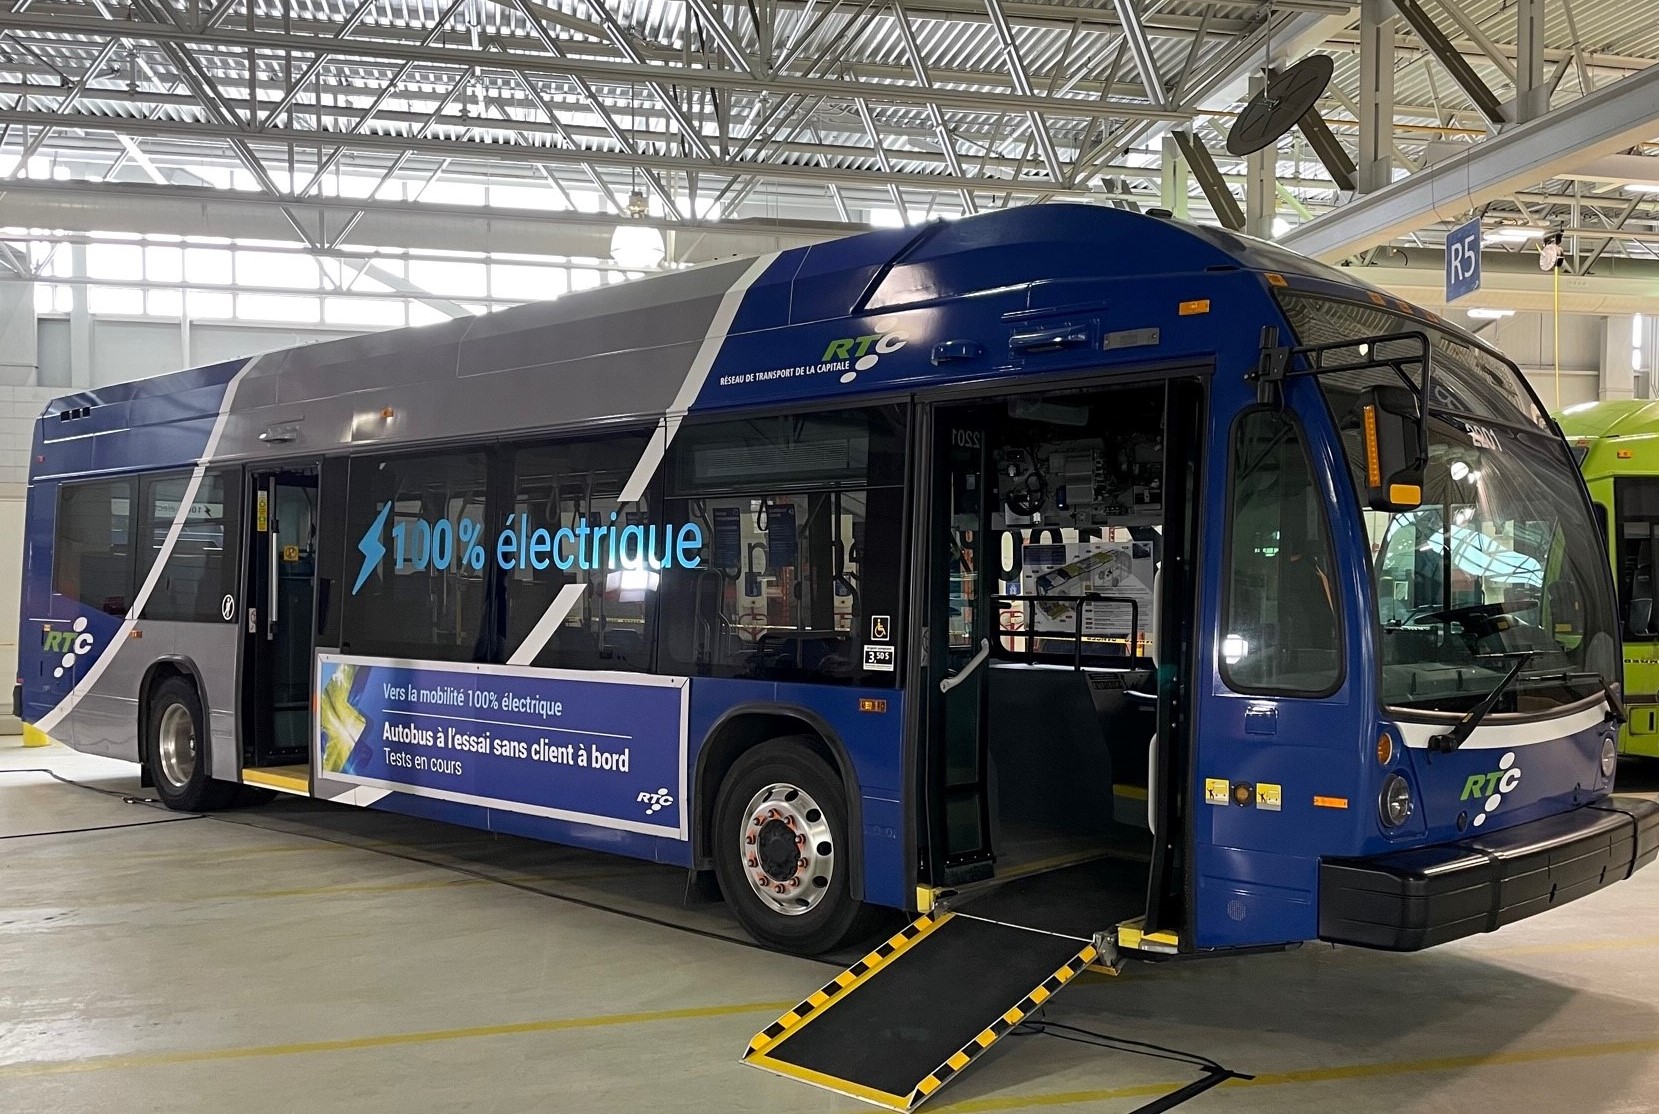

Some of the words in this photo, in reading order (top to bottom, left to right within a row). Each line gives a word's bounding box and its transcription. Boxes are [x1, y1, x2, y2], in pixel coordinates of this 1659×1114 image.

[1451, 234, 1475, 284] R5
[821, 330, 909, 361] RTC
[720, 373, 744, 385] RÉSEAU
[745, 373, 755, 382] DE
[755, 368, 794, 381] TRANSPORT
[795, 366, 805, 376] DE
[806, 365, 815, 374] LA
[816, 361, 850, 373] CAPITALE
[391, 517, 485, 570] 100%
[497, 511, 703, 572] électrique
[43, 630, 94, 655] RTC
[383, 683, 405, 701] Vers
[407, 687, 418, 702] la
[420, 689, 464, 706] mobilité
[467, 690, 499, 710] 100%
[501, 692, 563, 719] électrique
[382, 721, 433, 747] Autobus
[436, 727, 445, 748] à
[493, 738, 528, 759] sans
[531, 739, 574, 765] client
[578, 744, 587, 767] à
[591, 745, 629, 772] bord
[383, 747, 412, 768] Tests
[414, 755, 428, 771] en
[430, 757, 462, 775] cours
[636, 791, 674, 806] RTC
[1460, 767, 1521, 801] RTC
